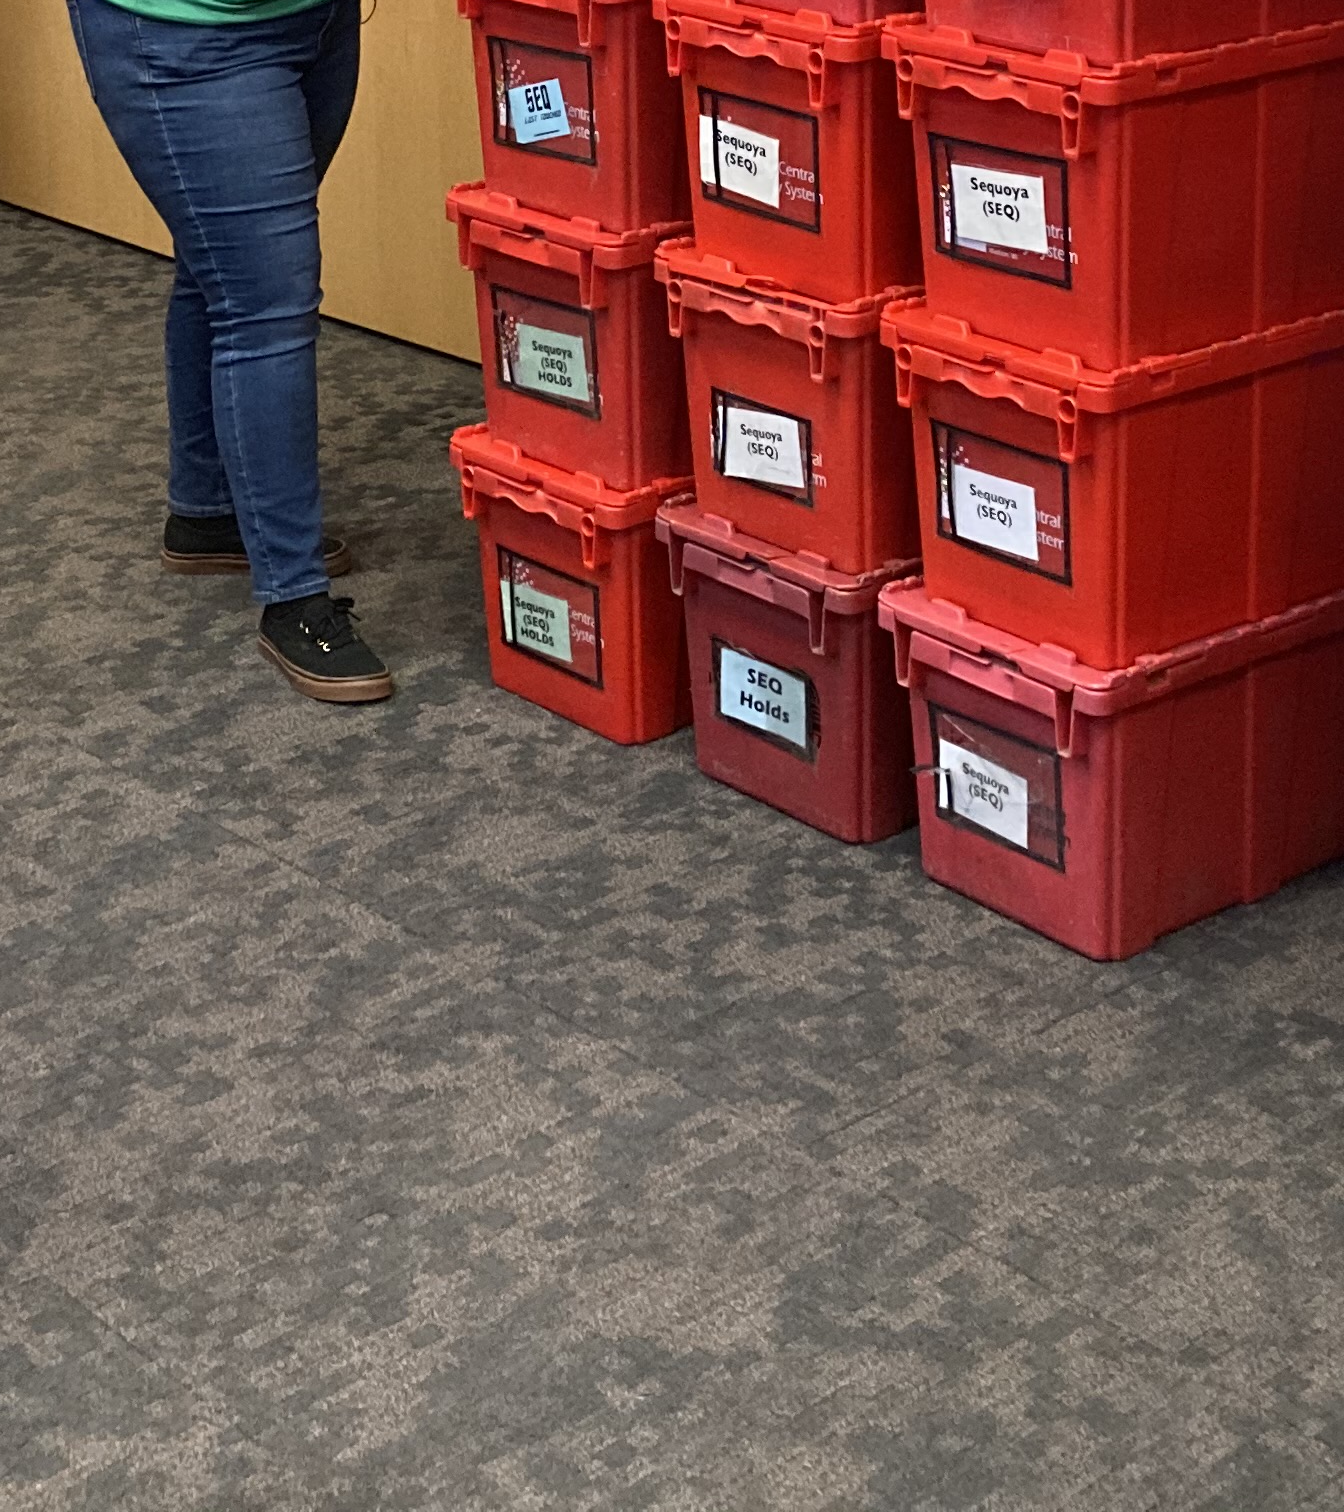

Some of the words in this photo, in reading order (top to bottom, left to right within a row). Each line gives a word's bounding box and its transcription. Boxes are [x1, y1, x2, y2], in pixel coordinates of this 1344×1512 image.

[524, 84, 552, 113] SEQ
[716, 129, 767, 157] Sequoya
[724, 151, 758, 176] (SEQ)
[779, 161, 815, 183] Centra
[970, 176, 1029, 201] Sequoya
[982, 200, 1020, 223] (SEQ)
[531, 340, 573, 360] Sequoya
[541, 356, 568, 374] (SEQ)
[538, 370, 573, 388] HOLDS
[740, 423, 783, 444] Sequoya
[747, 441, 779, 462] (SEQ)
[969, 483, 1018, 510] Sequoya
[976, 503, 1013, 529] (SEQ)
[515, 596, 556, 620] Sequoya
[523, 613, 550, 634] (SEQ)
[520, 626, 555, 647] HOLDS
[747, 668, 783, 696] SEQ
[740, 690, 790, 724] Holds
[962, 761, 1010, 796] Sequoya
[968, 782, 1004, 813] (SEQ)
